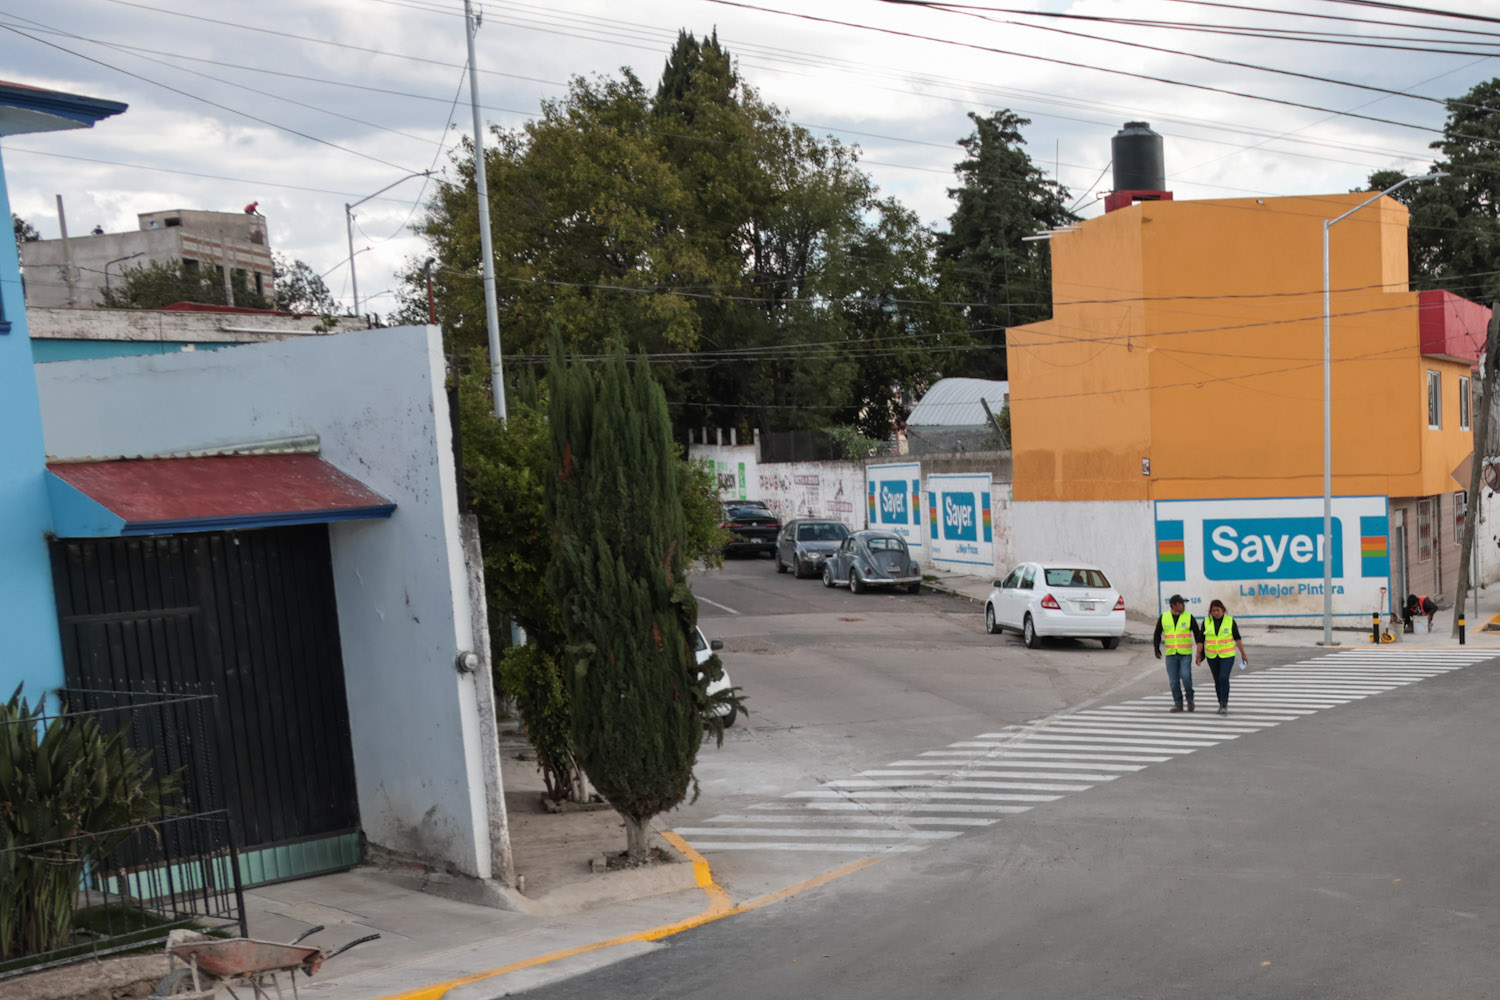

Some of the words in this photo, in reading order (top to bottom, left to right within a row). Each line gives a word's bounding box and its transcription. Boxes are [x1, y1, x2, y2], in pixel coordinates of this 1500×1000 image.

[882, 486, 905, 519] Sayer
[945, 496, 972, 535] Sayer
[1240, 584, 1255, 596] La
[1258, 583, 1294, 599] Mejor
[1298, 583, 1344, 595] Pintra
